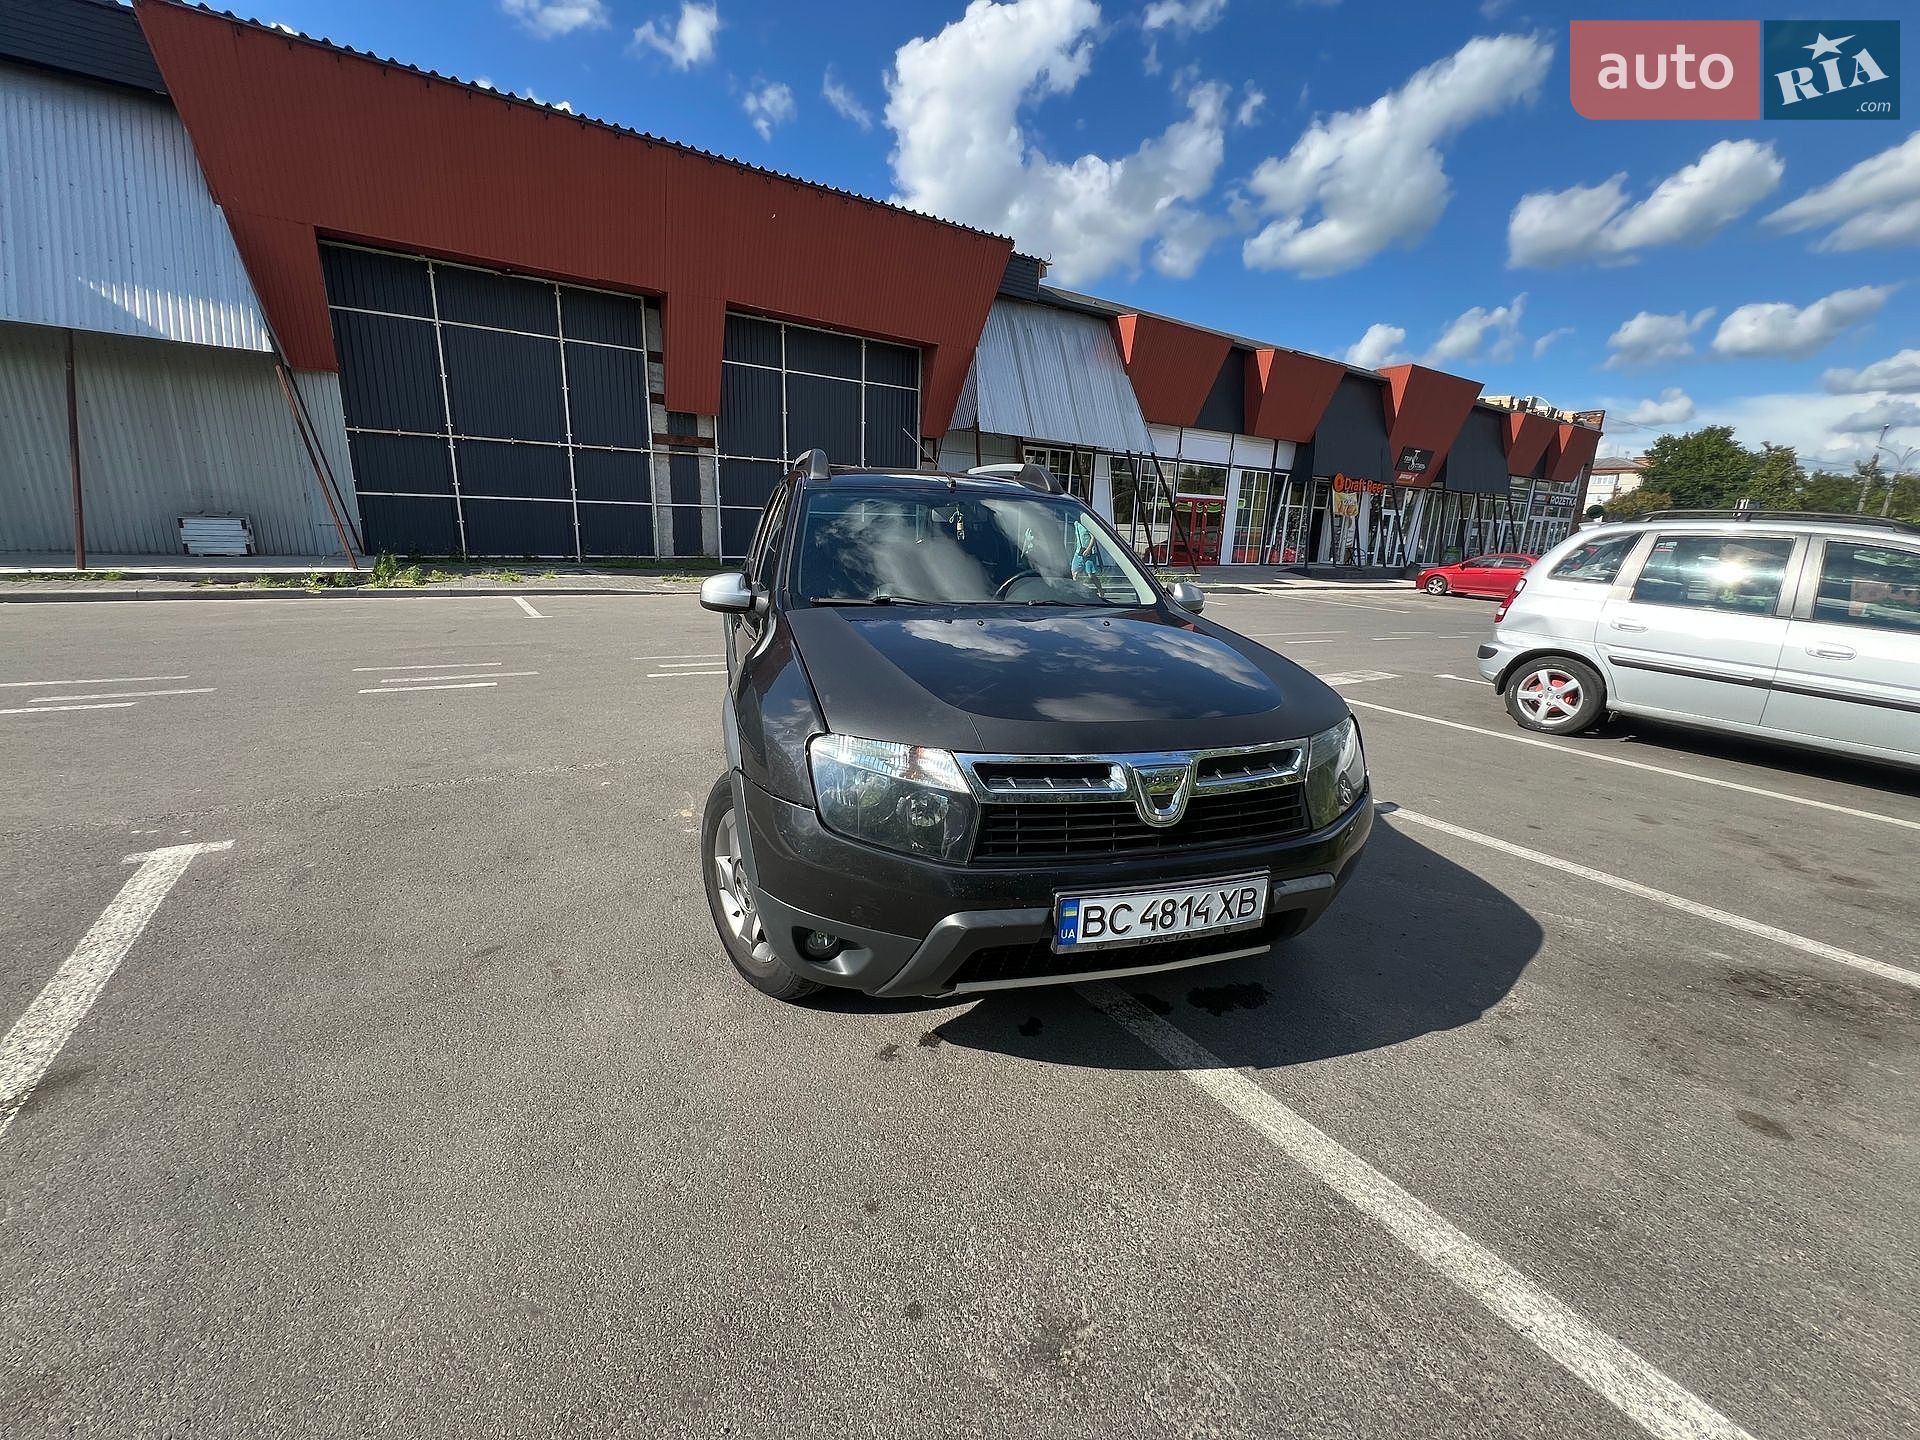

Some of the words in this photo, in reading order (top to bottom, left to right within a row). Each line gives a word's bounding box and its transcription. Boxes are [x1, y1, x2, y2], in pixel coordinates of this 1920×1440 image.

[1344, 477, 1366, 491] Draft
[1367, 479, 1384, 493] Beer
[1550, 495, 1577, 507] ROZETKA
[1145, 775, 1180, 784] DACIA
[1081, 903, 1132, 938] BC
[1140, 893, 1212, 931] 4814
[1215, 887, 1258, 922] XB
[1060, 928, 1076, 939] UA
